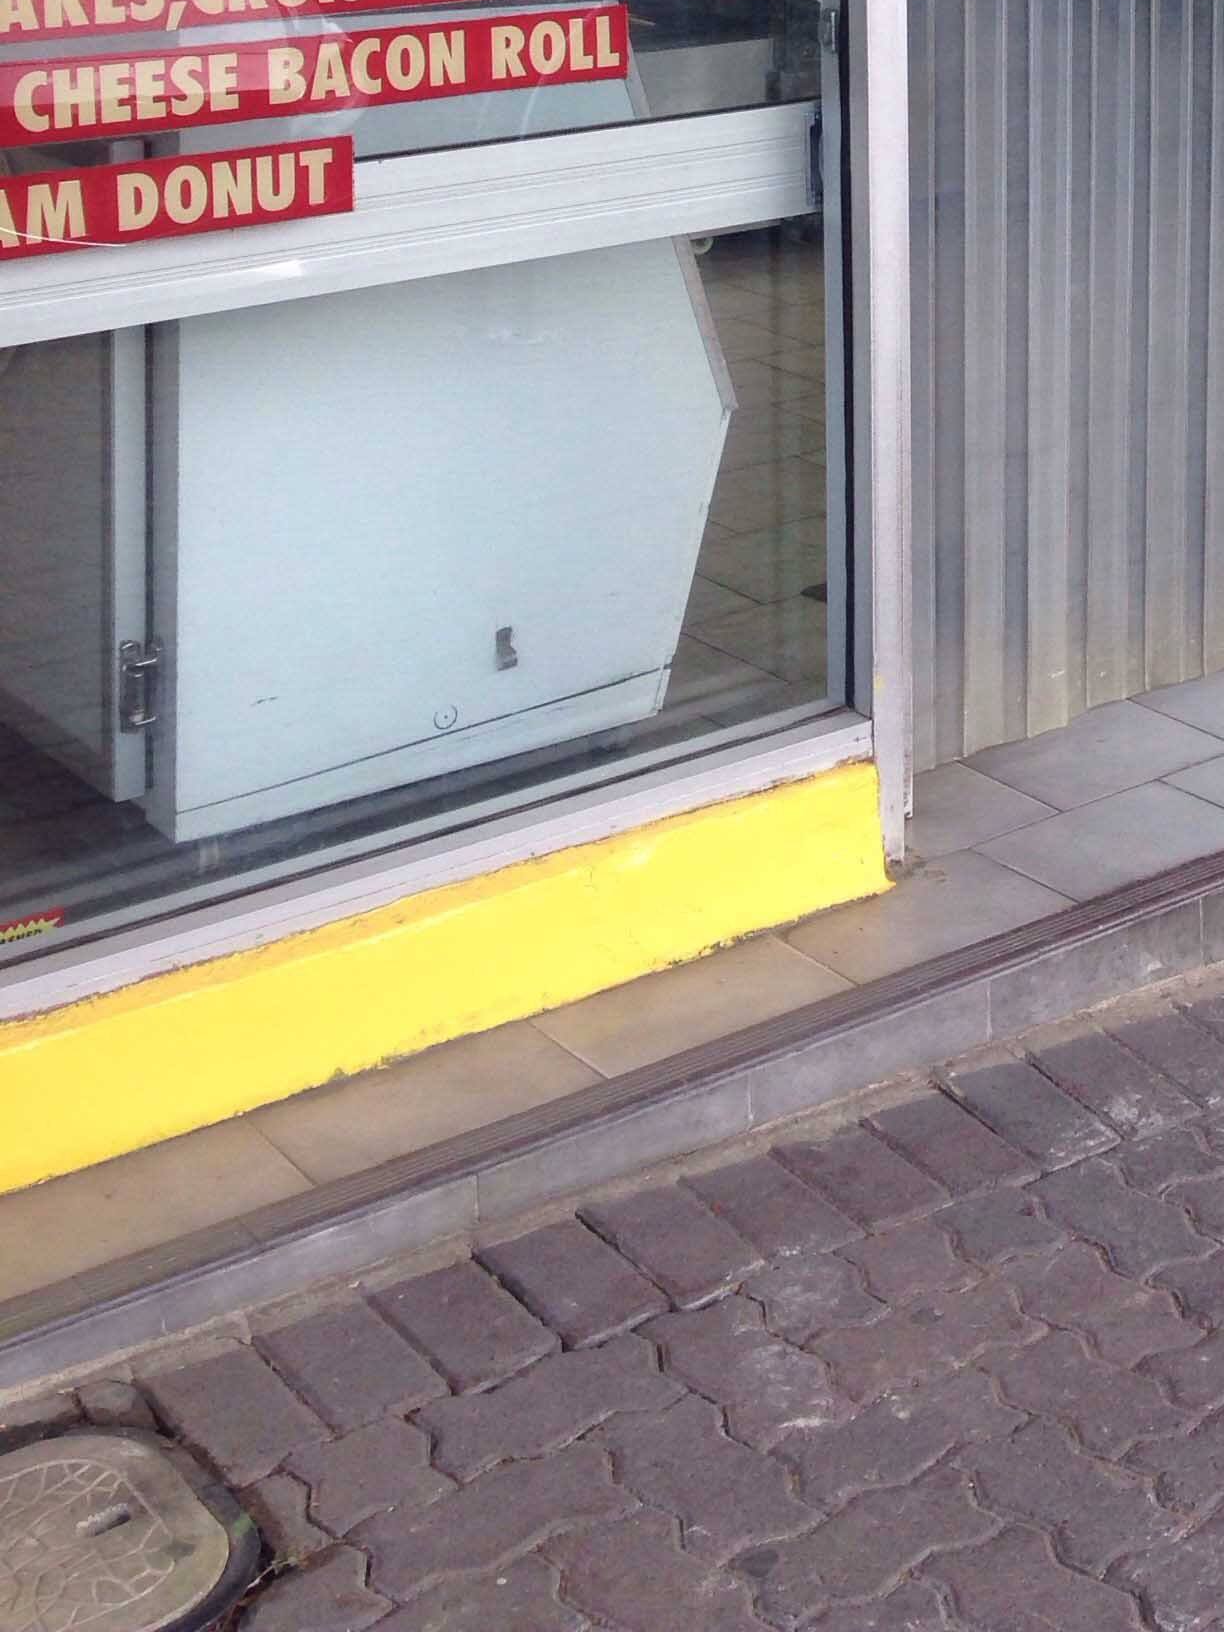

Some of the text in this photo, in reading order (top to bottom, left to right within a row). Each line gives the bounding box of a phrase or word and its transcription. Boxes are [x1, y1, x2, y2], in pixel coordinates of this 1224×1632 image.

[14, 13, 622, 133] CHEESE BACON ROLL
[117, 146, 334, 233] DONUT
